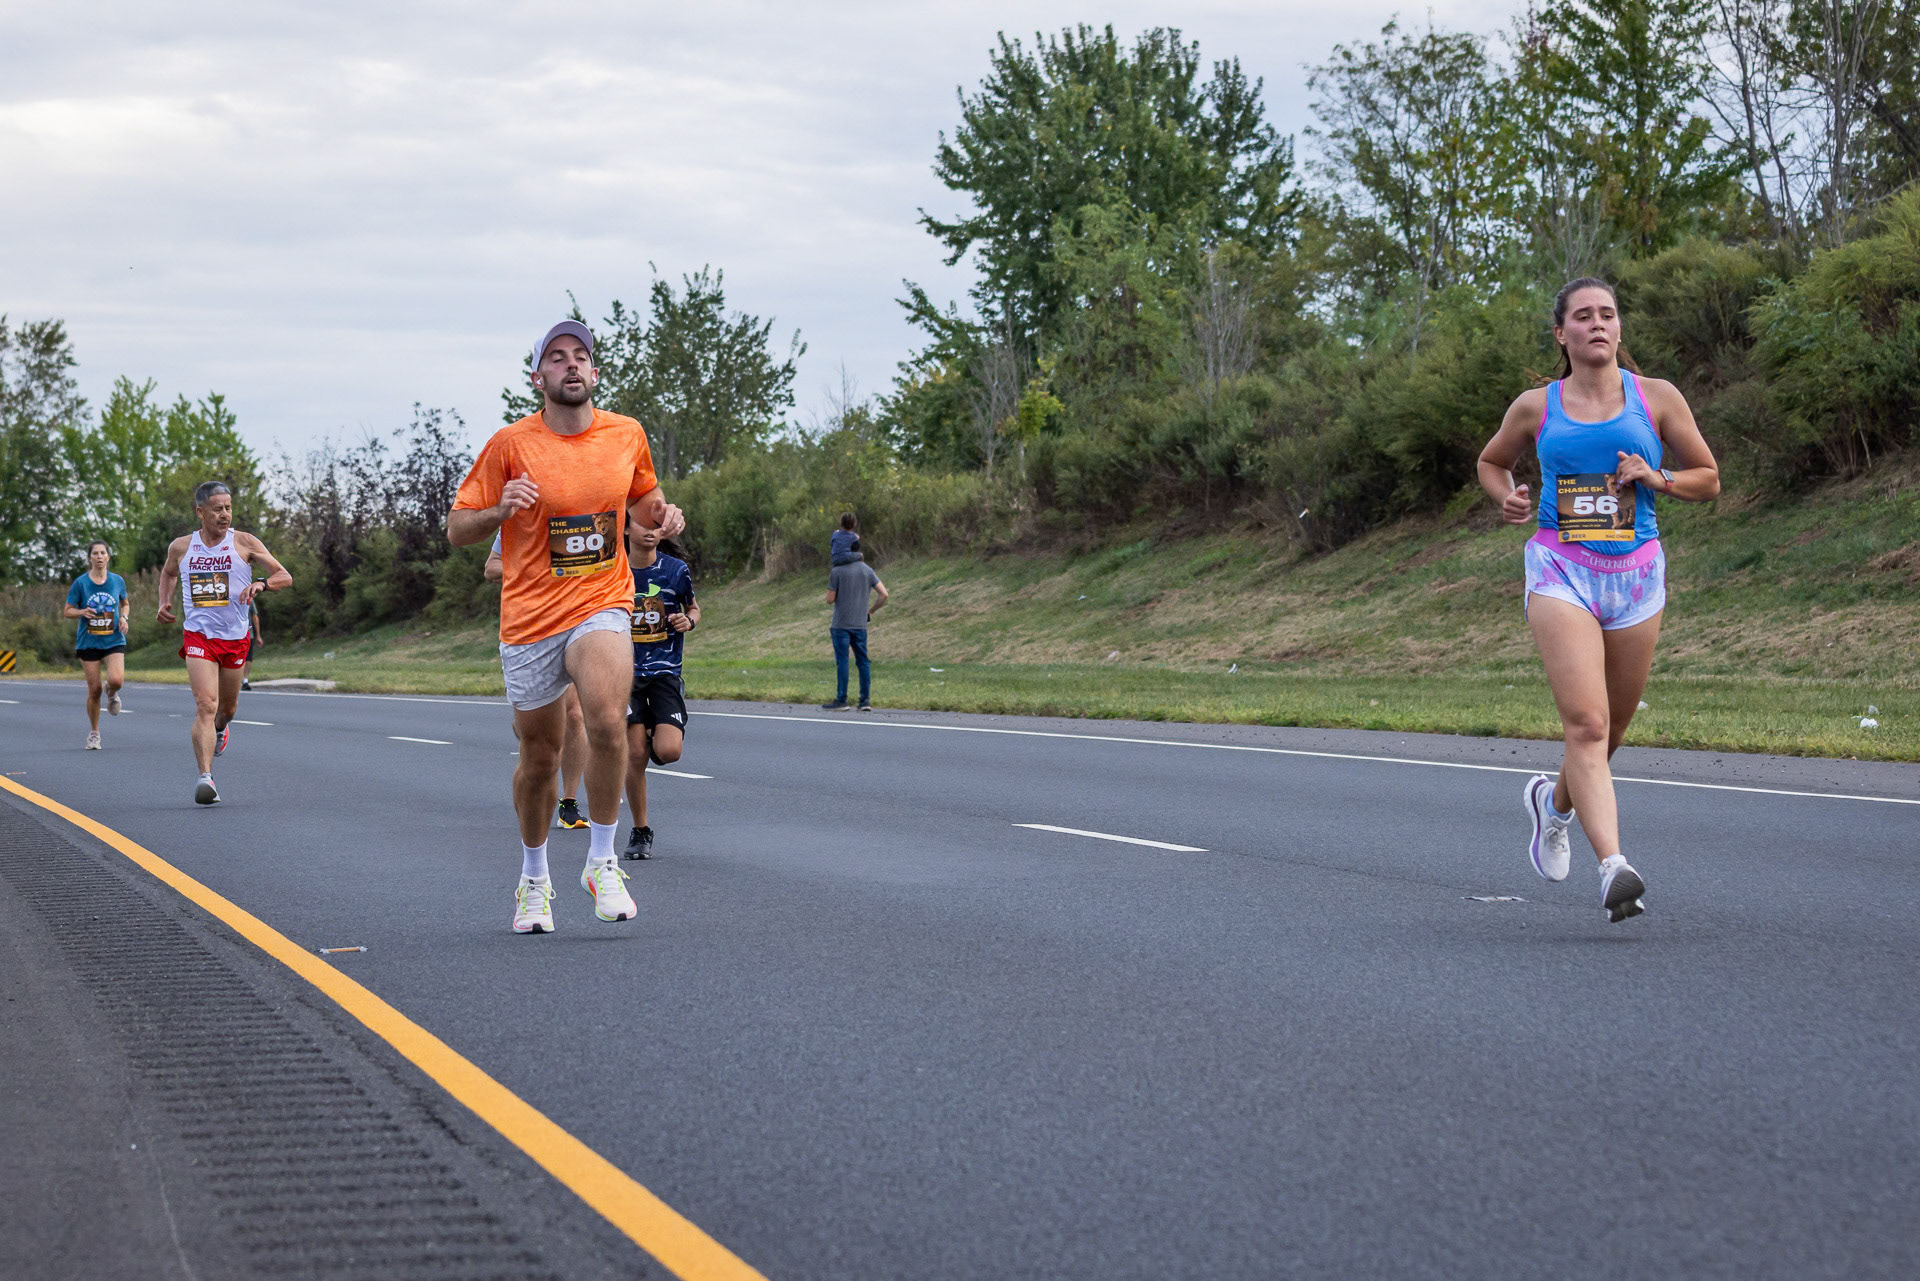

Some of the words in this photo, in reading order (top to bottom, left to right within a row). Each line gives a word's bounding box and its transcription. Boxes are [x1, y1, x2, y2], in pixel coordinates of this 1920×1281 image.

[1573, 496, 1618, 514] 56
[566, 534, 604, 553] 80
[189, 555, 232, 565] LEONIA
[193, 583, 226, 594] 243
[188, 646, 204, 657] LEONIA
